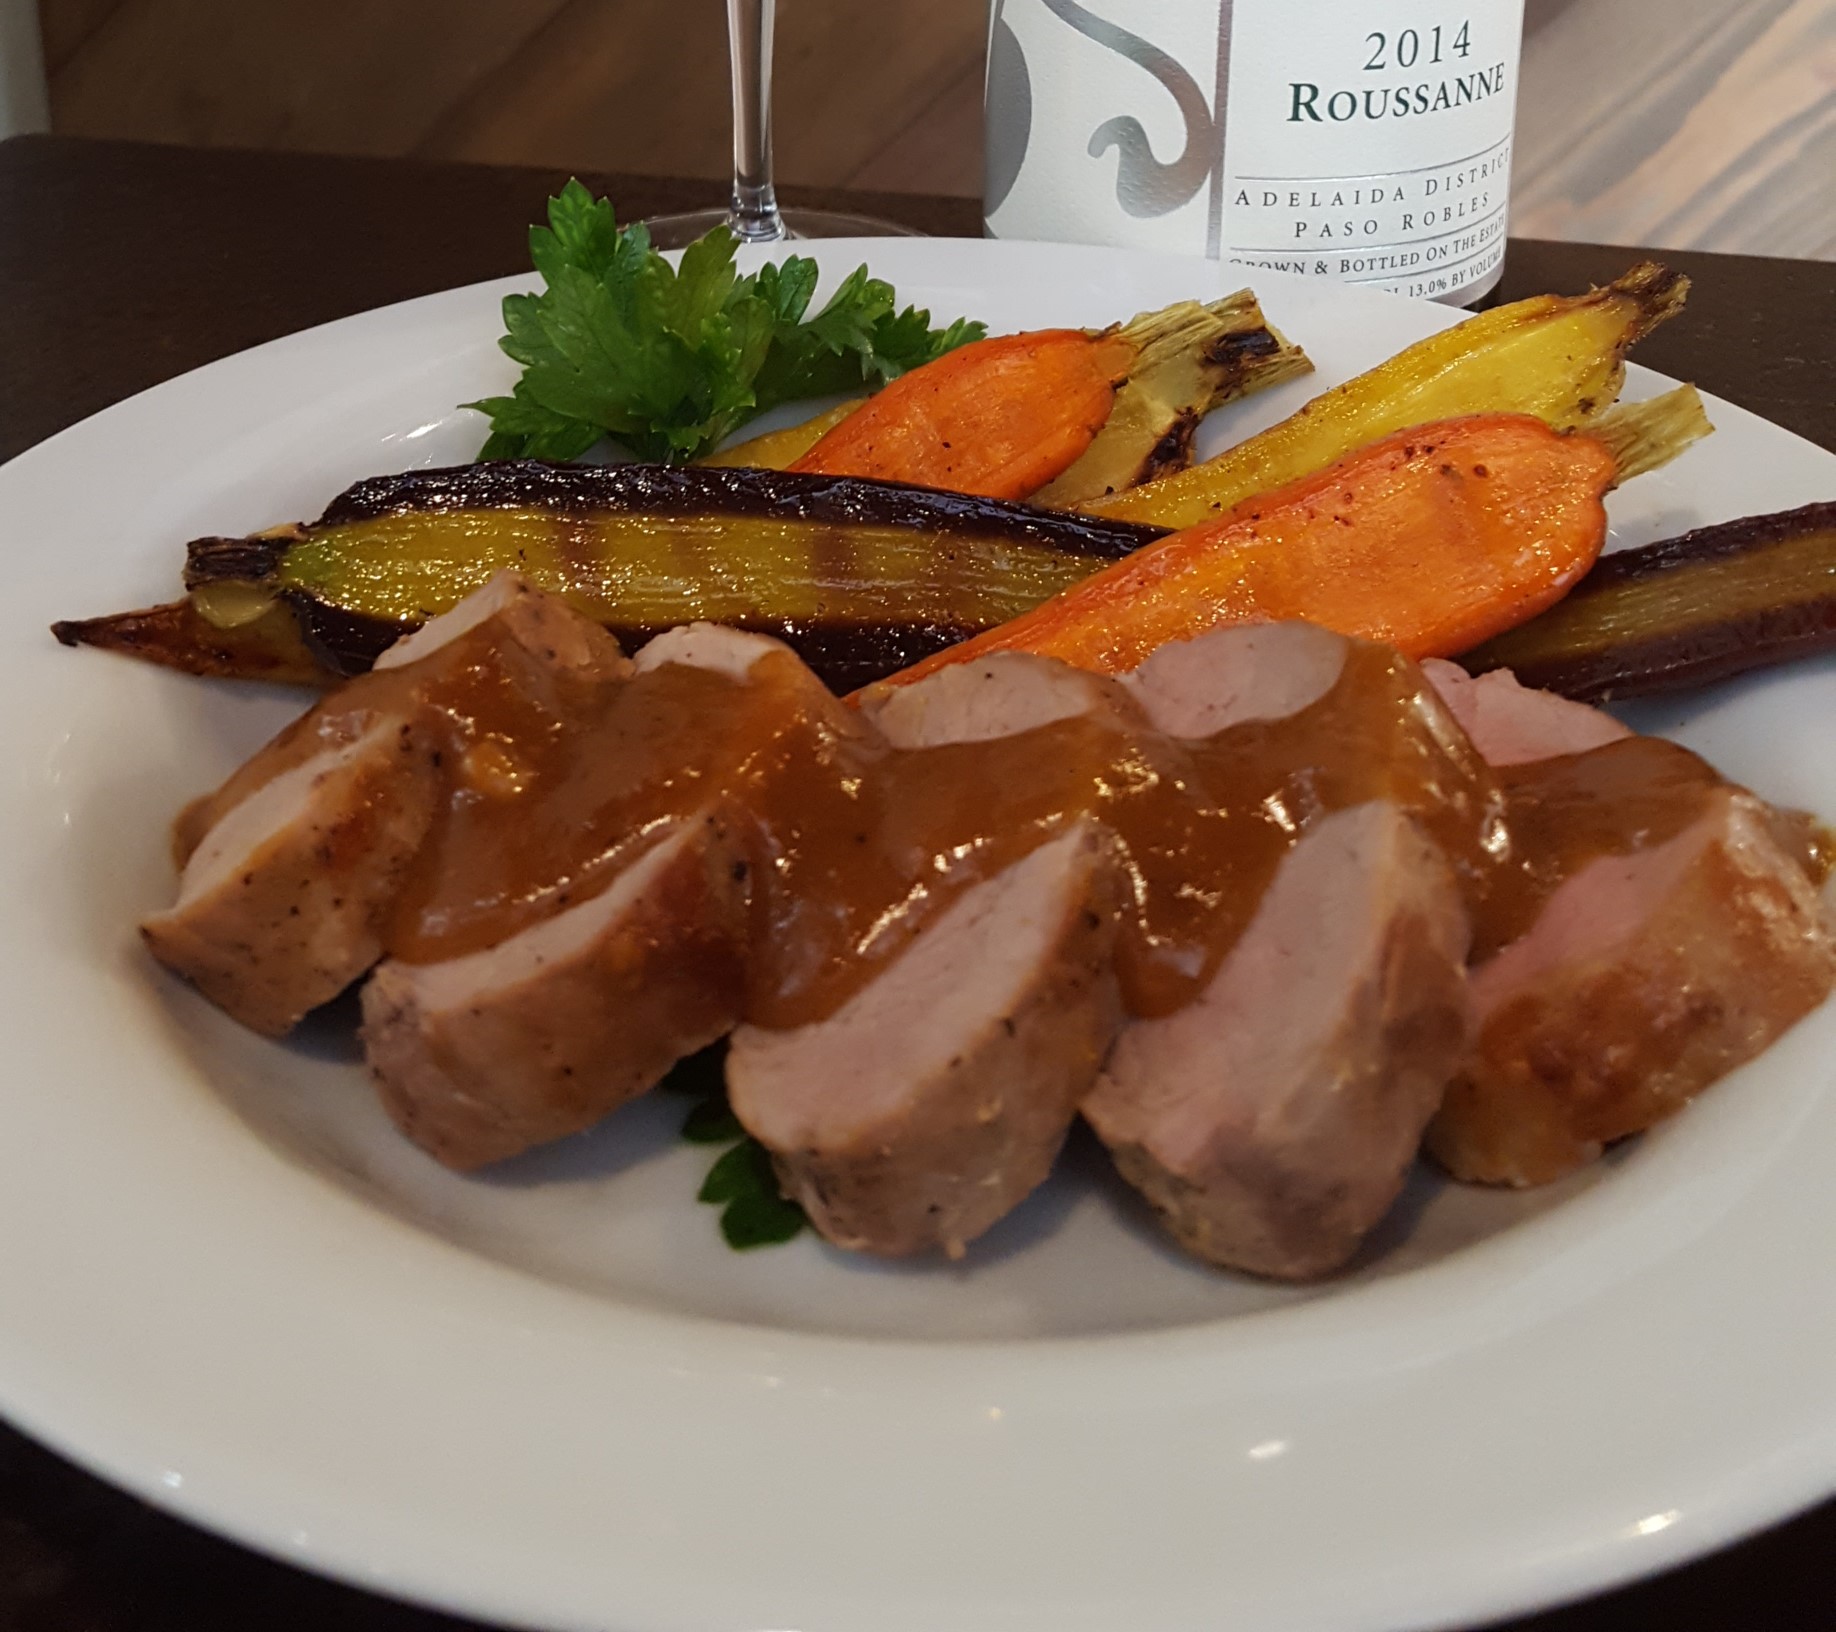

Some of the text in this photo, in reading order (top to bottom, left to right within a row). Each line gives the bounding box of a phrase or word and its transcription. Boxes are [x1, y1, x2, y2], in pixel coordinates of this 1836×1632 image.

[1362, 19, 1471, 71] 2014
[1286, 62, 1505, 122] ROUSSANNE
[1234, 146, 1510, 207] ADELAIDA DISTRICT
[1295, 191, 1489, 238] PASO ROBLES
[1314, 259, 1328, 275] &
[1340, 252, 1420, 274] BOTTLED
[1426, 245, 1449, 262] ON
[1453, 234, 1476, 255] THE
[1409, 278, 1447, 298] 13.0%
[1451, 269, 1466, 288] BY
